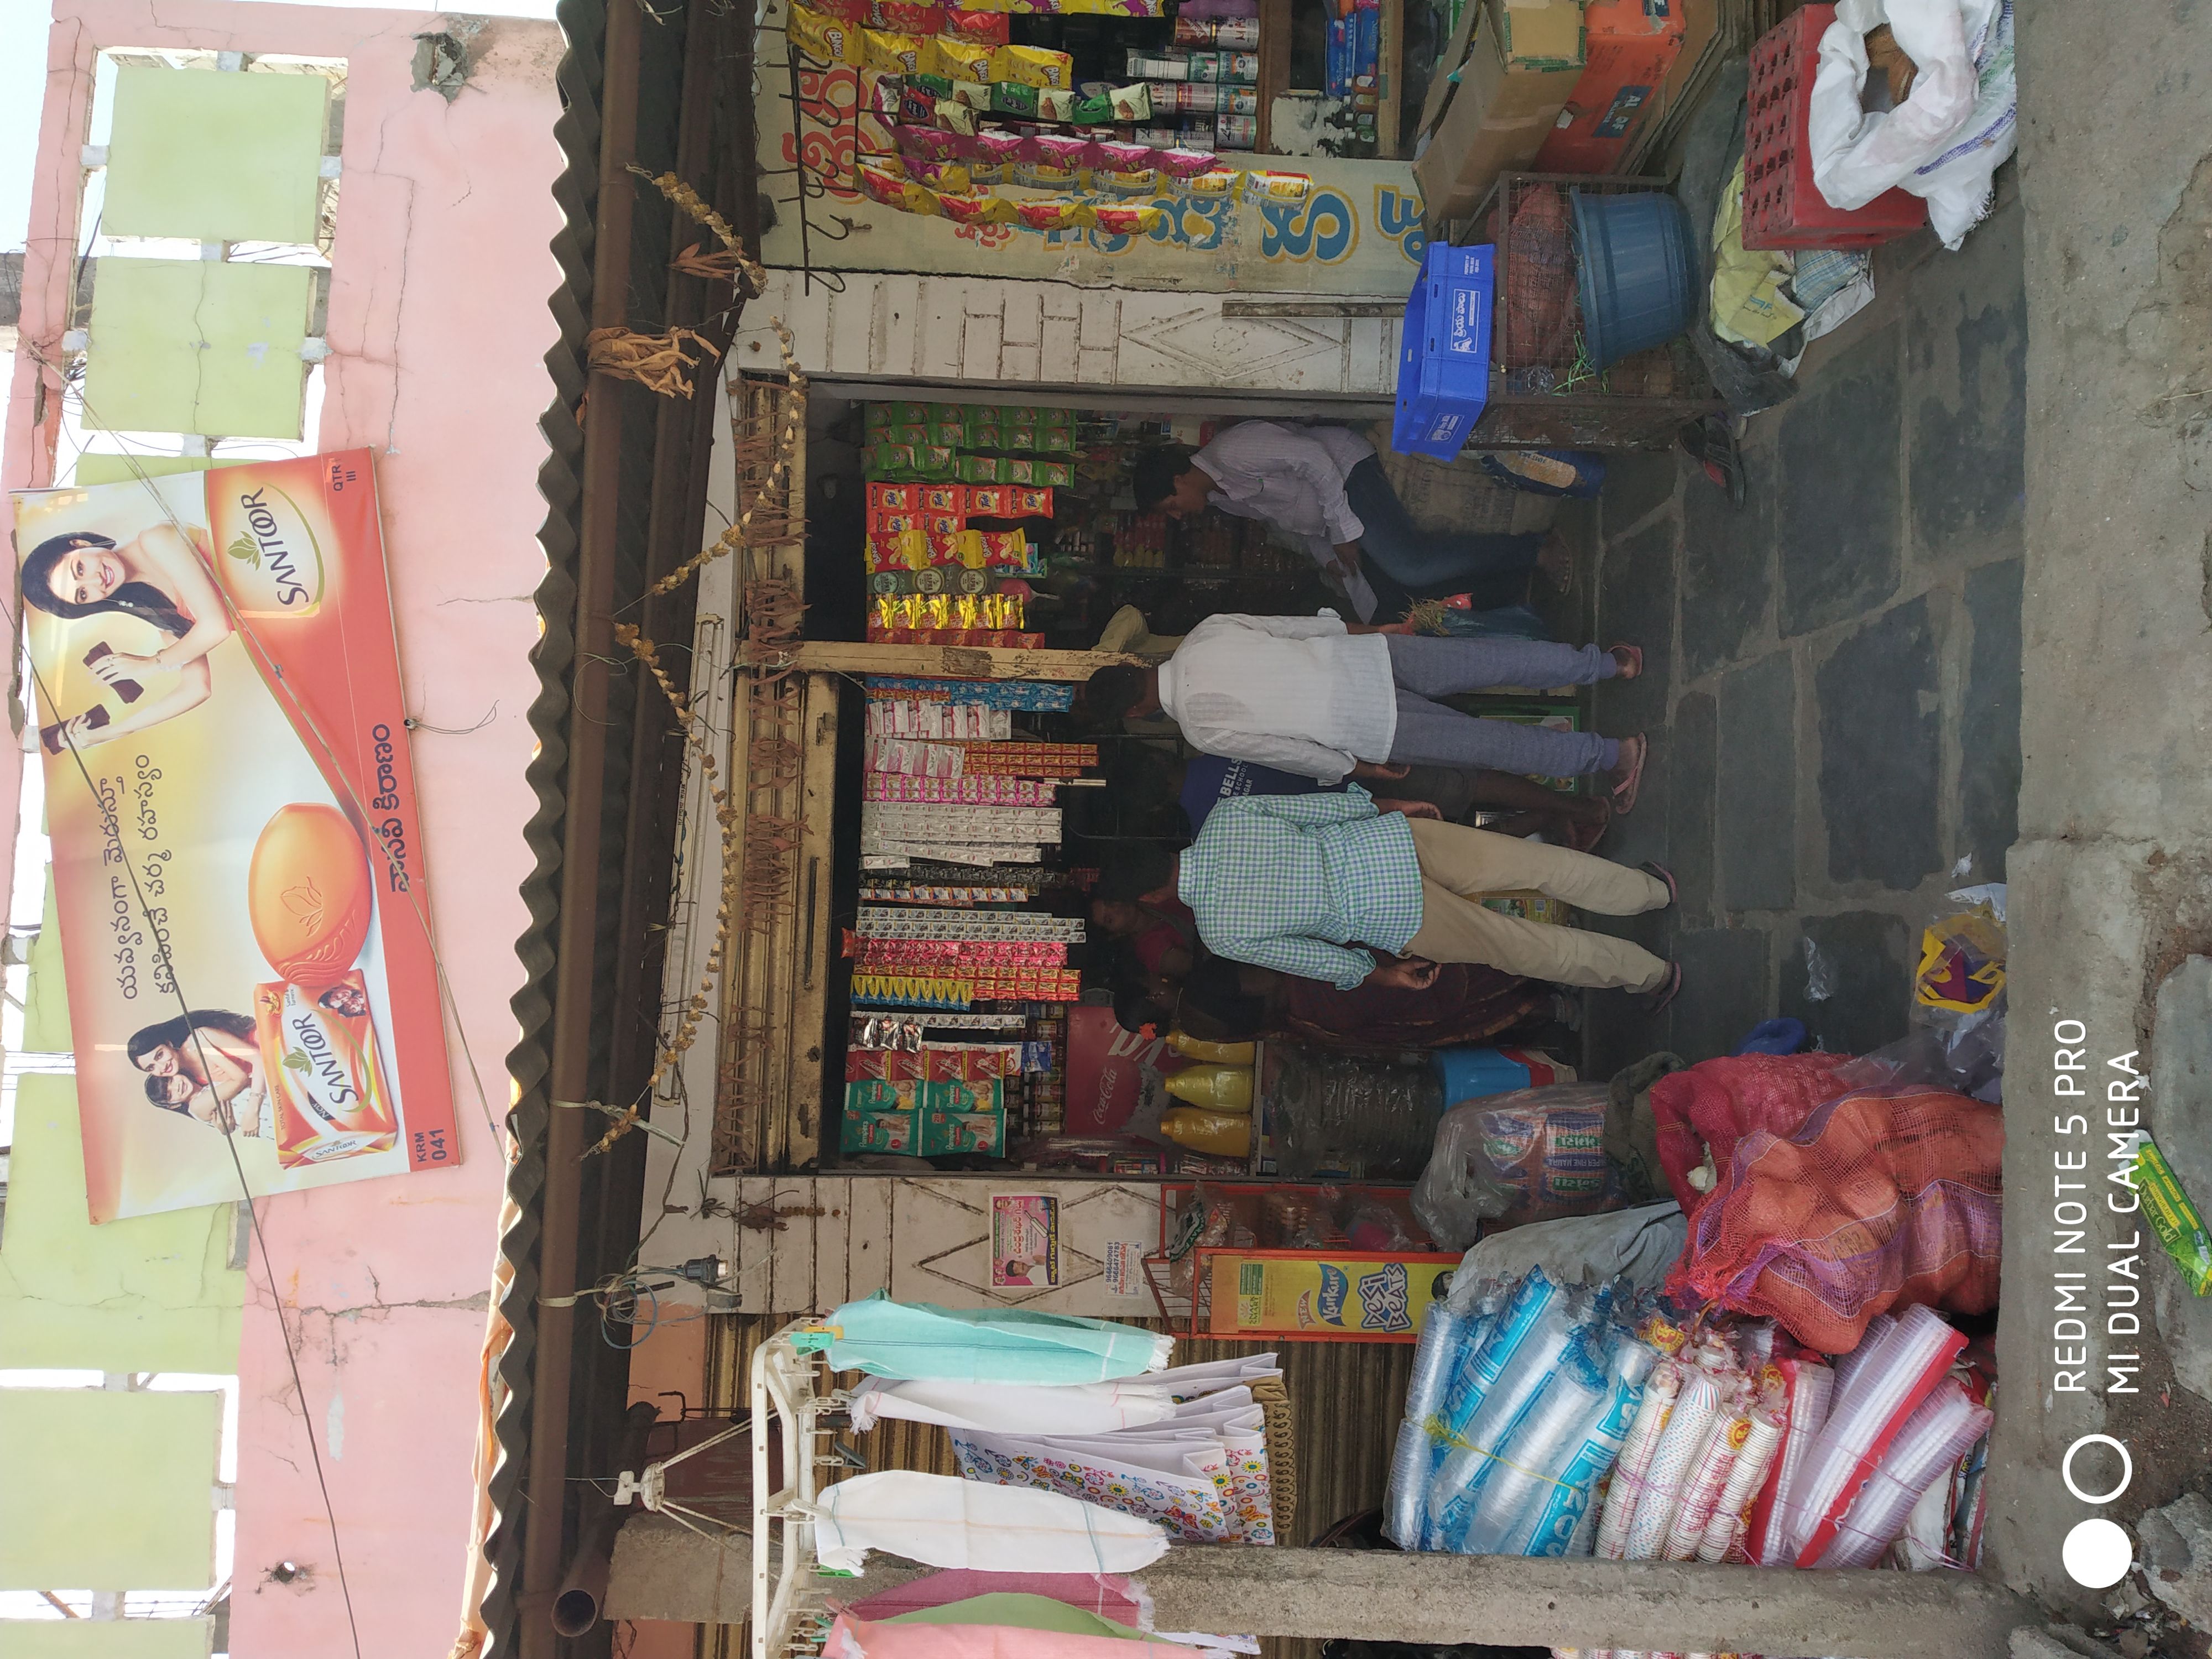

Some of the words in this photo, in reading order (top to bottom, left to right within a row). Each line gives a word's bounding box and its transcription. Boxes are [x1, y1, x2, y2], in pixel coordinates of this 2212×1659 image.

[1456, 292, 1467, 315] పాలు
[1453, 315, 1467, 337] ప్రియ
[331, 464, 343, 491] QTR
[886, 492, 897, 506] Tide
[933, 492, 943, 507] Tide
[979, 493, 990, 508] Tide
[1025, 494, 1037, 509] Tide
[938, 519, 948, 534] Tide
[239, 487, 310, 606] SANTOOR
[869, 541, 881, 565] BINGO!
[925, 536, 937, 560] BINGO!
[980, 535, 993, 558] BINGO!
[372, 724, 400, 810] కిరాణం
[1219, 758, 1242, 796] BELLS
[1234, 764, 1249, 791] SCHOOL
[133, 754, 162, 841] రహస్యం
[1242, 779, 1253, 796] AGAR
[142, 849, 172, 898] చర్మ
[291, 1012, 359, 1104] SANTOOR
[868, 1081, 878, 1104] Pampers
[947, 1084, 956, 1108] Pampers
[311, 1102, 329, 1118] New
[414, 1131, 427, 1162] KRM
[429, 1128, 447, 1161] 041
[858, 1120, 869, 1147] Pampers
[944, 1123, 955, 1150] Pampers
[2135, 1183, 2159, 1219] Durbar
[2153, 1215, 2177, 1244] Gold
[1319, 1267, 1342, 1319] Kurkure
[1298, 1297, 1309, 1323] NEW
